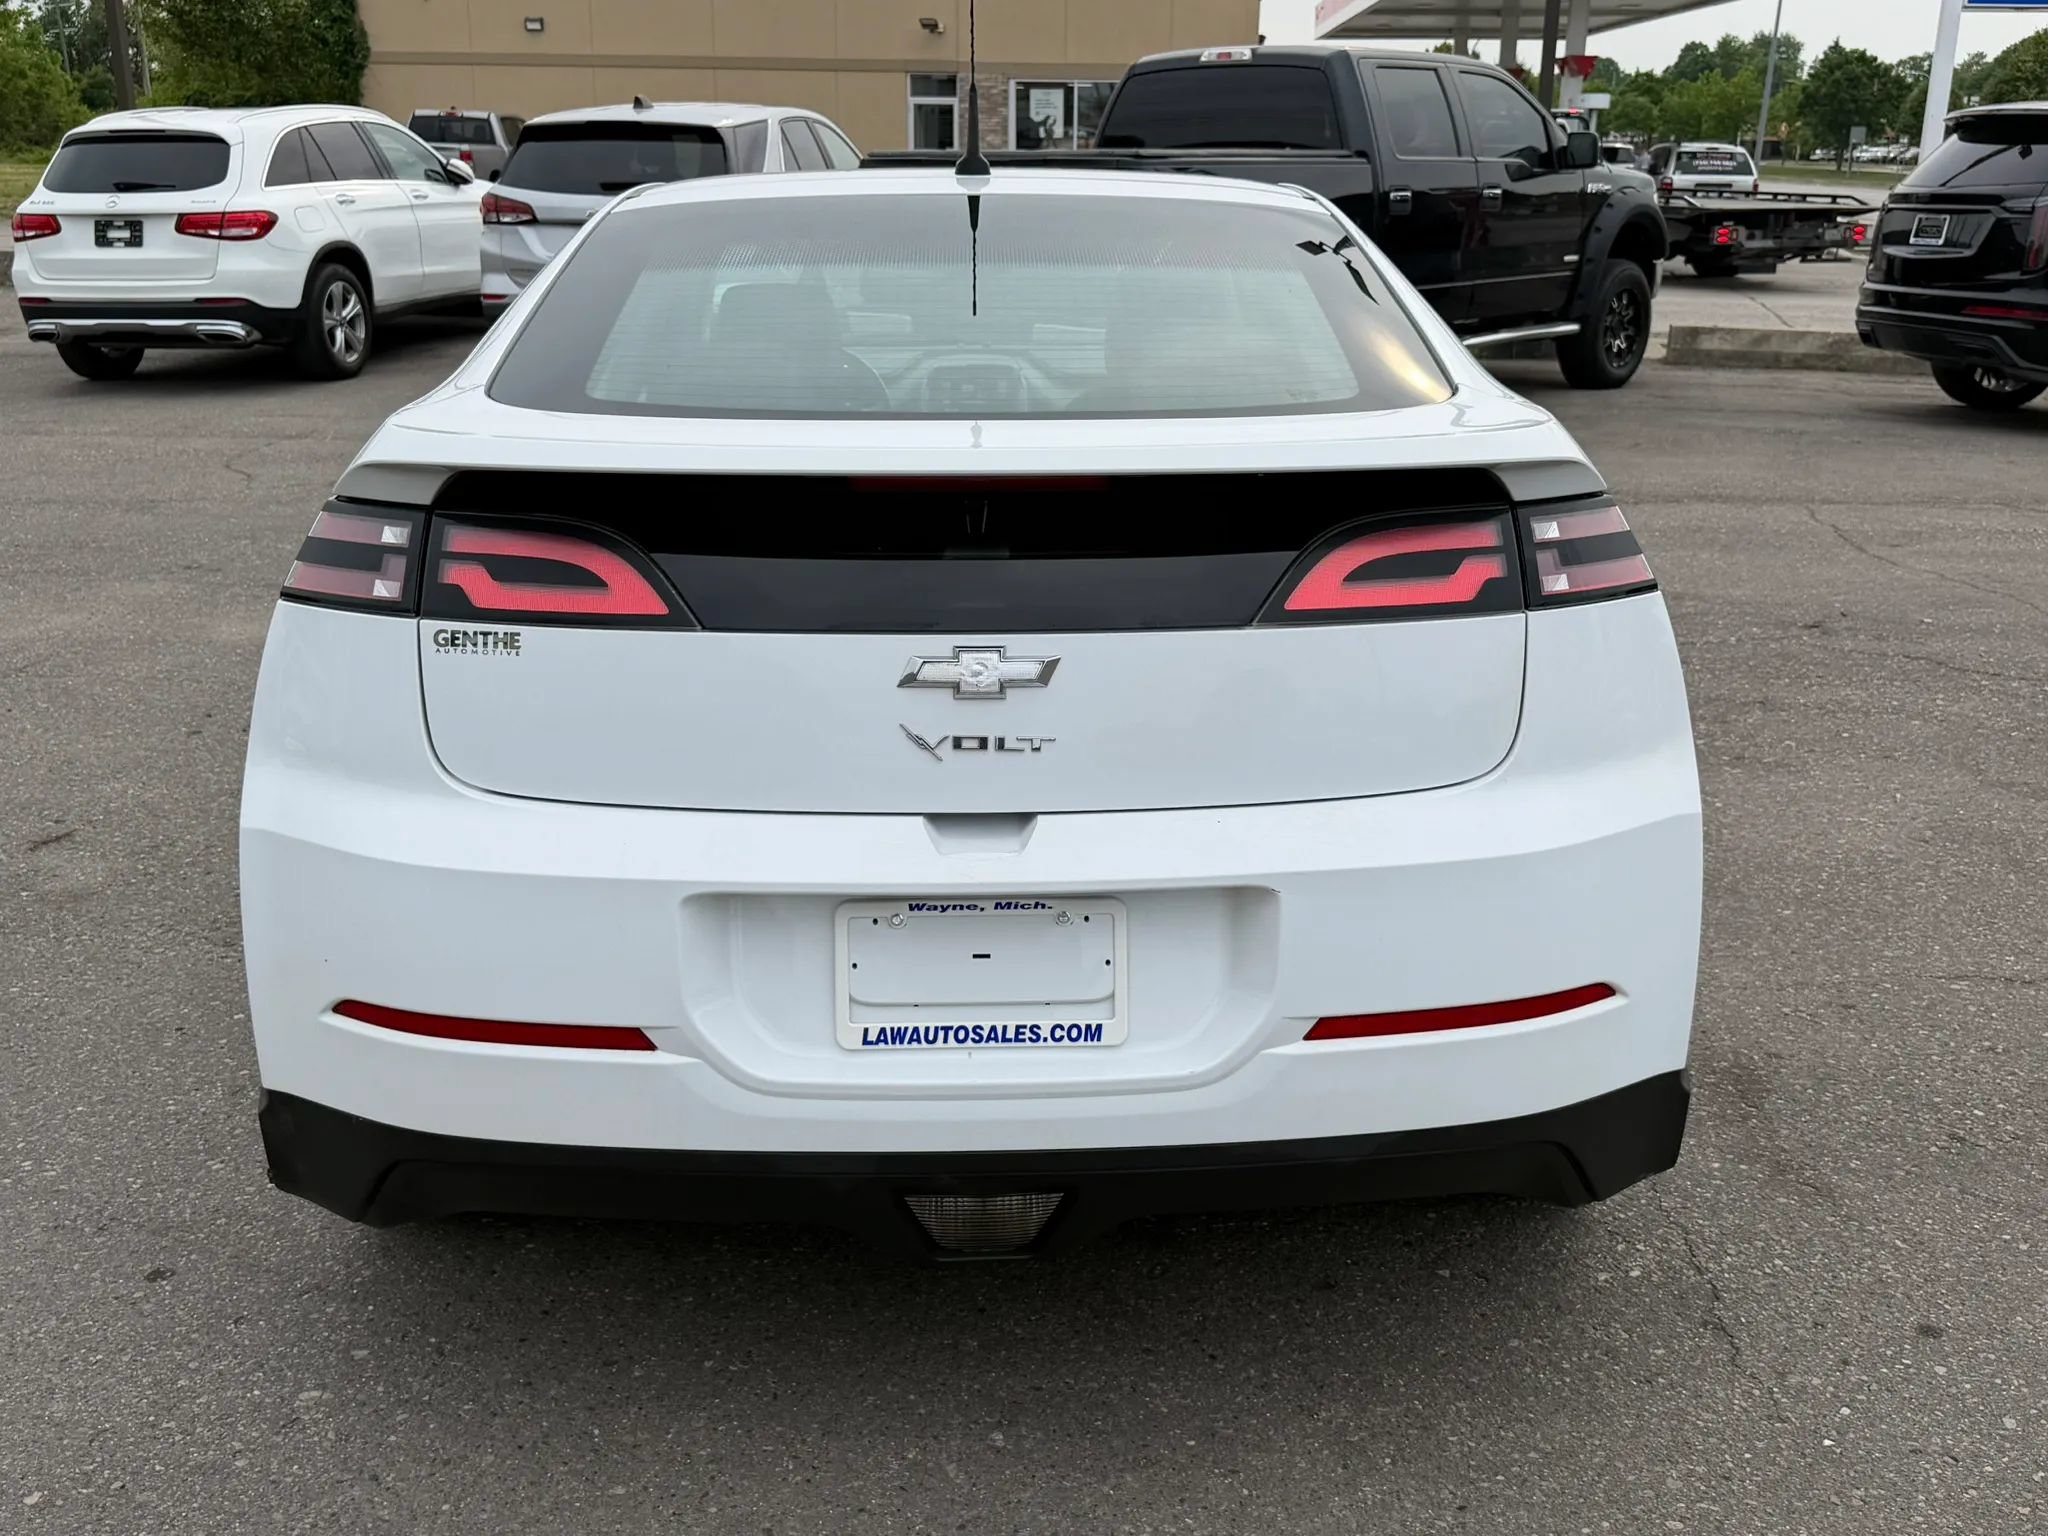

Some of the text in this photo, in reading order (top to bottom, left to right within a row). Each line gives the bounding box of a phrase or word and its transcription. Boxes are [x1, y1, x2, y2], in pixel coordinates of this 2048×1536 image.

[433, 629, 521, 649] GENTHE
[435, 648, 520, 656] AUTOMOTIVE
[899, 723, 1056, 761] VOLT
[907, 901, 1054, 914] Wayne, Mich.
[861, 1023, 1104, 1047] LAWAUTOSALES.COM
